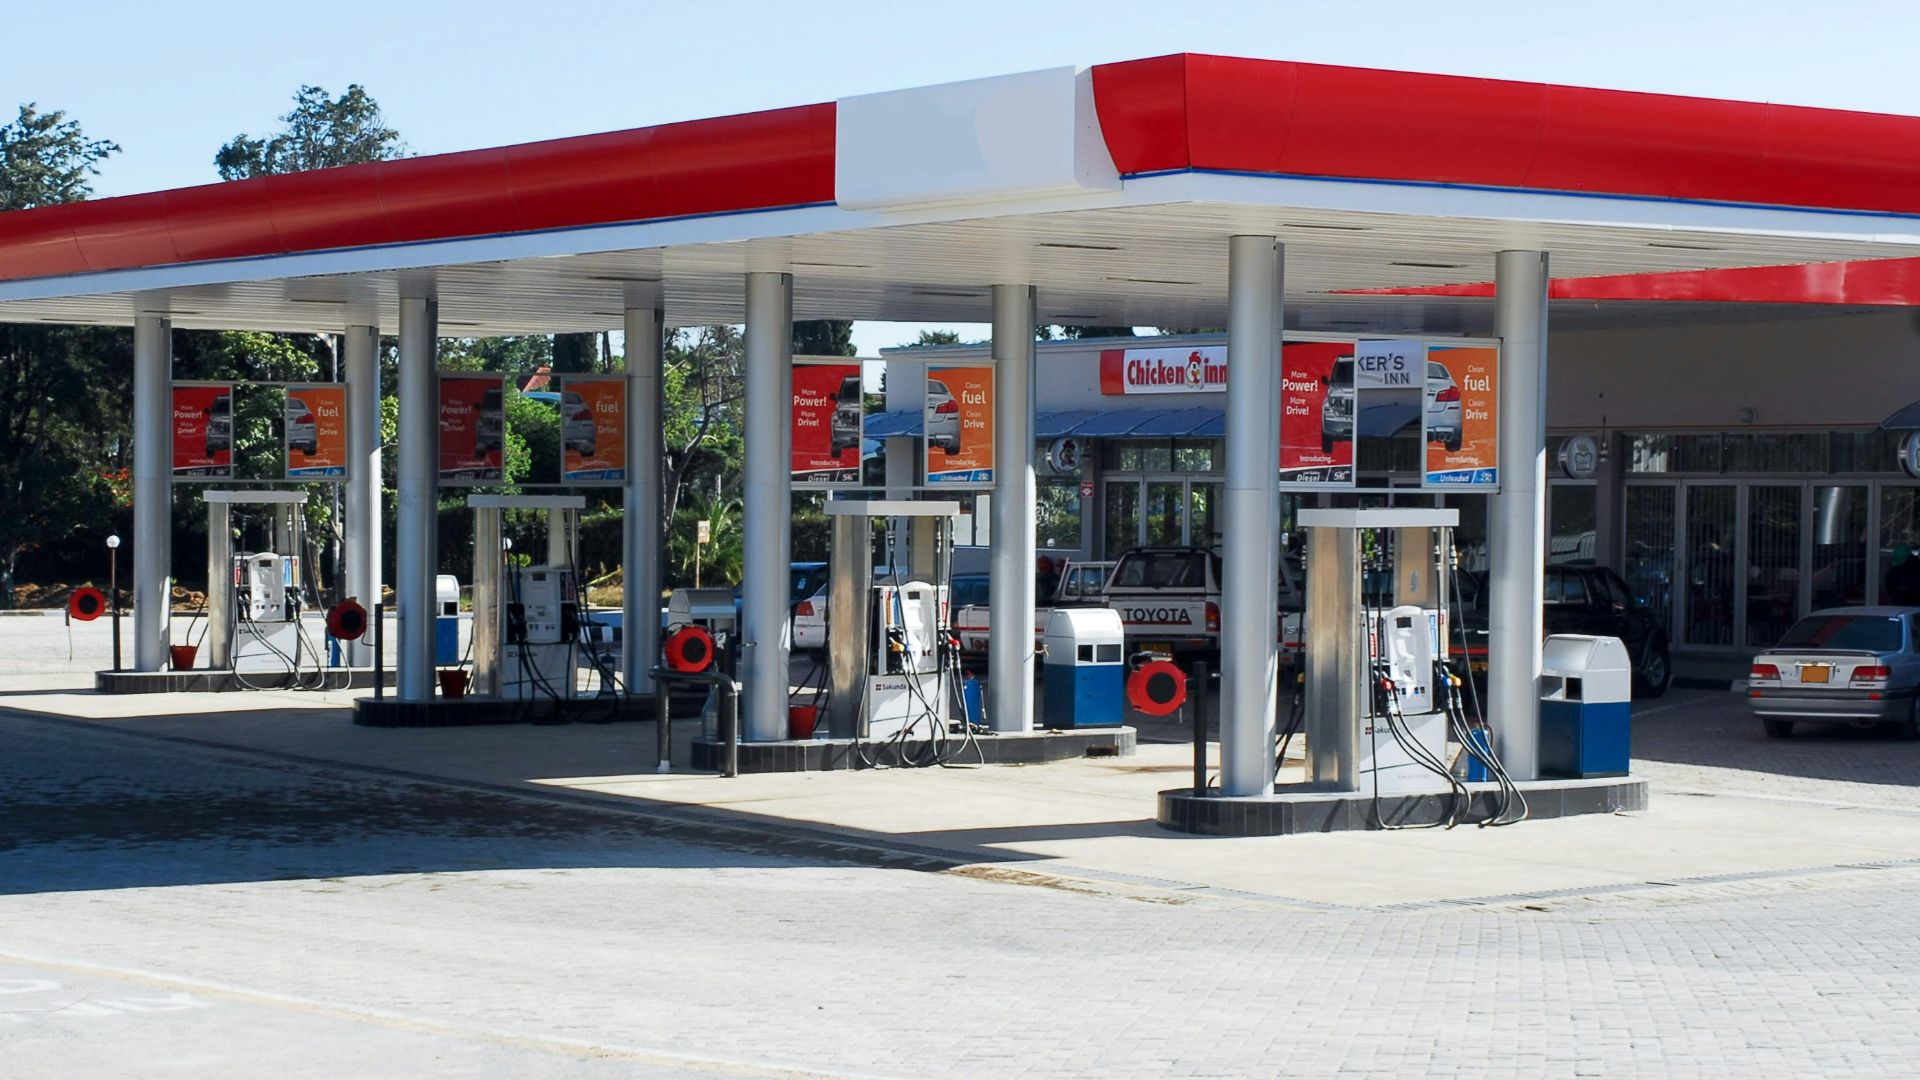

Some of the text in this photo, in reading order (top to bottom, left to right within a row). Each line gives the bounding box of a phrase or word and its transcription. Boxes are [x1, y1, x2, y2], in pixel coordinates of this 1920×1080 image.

[1127, 357, 1227, 385] Chicken inn
[1468, 365, 1485, 373] Clean
[1291, 370, 1308, 378] More
[1384, 372, 1410, 384] INN
[1282, 378, 1318, 392] Power!
[1464, 375, 1490, 391] fuel
[801, 388, 817, 396] More
[793, 395, 827, 407] Power!
[961, 391, 986, 404] fuel
[1290, 397, 1306, 405] More
[595, 401, 619, 413] fuel
[1468, 399, 1485, 407] Clean
[317, 406, 339, 417] fuel
[441, 405, 472, 414] Power!
[800, 410, 816, 418] More
[966, 410, 982, 418] Clean
[1286, 405, 1309, 415] Drive!
[174, 410, 202, 419] Power!
[1465, 409, 1488, 420] Drive
[797, 418, 819, 427] Drive!
[963, 419, 985, 429] Drive
[319, 427, 339, 436] Drive
[598, 426, 618, 434] Drive
[1123, 608, 1190, 622] TOYOTA
